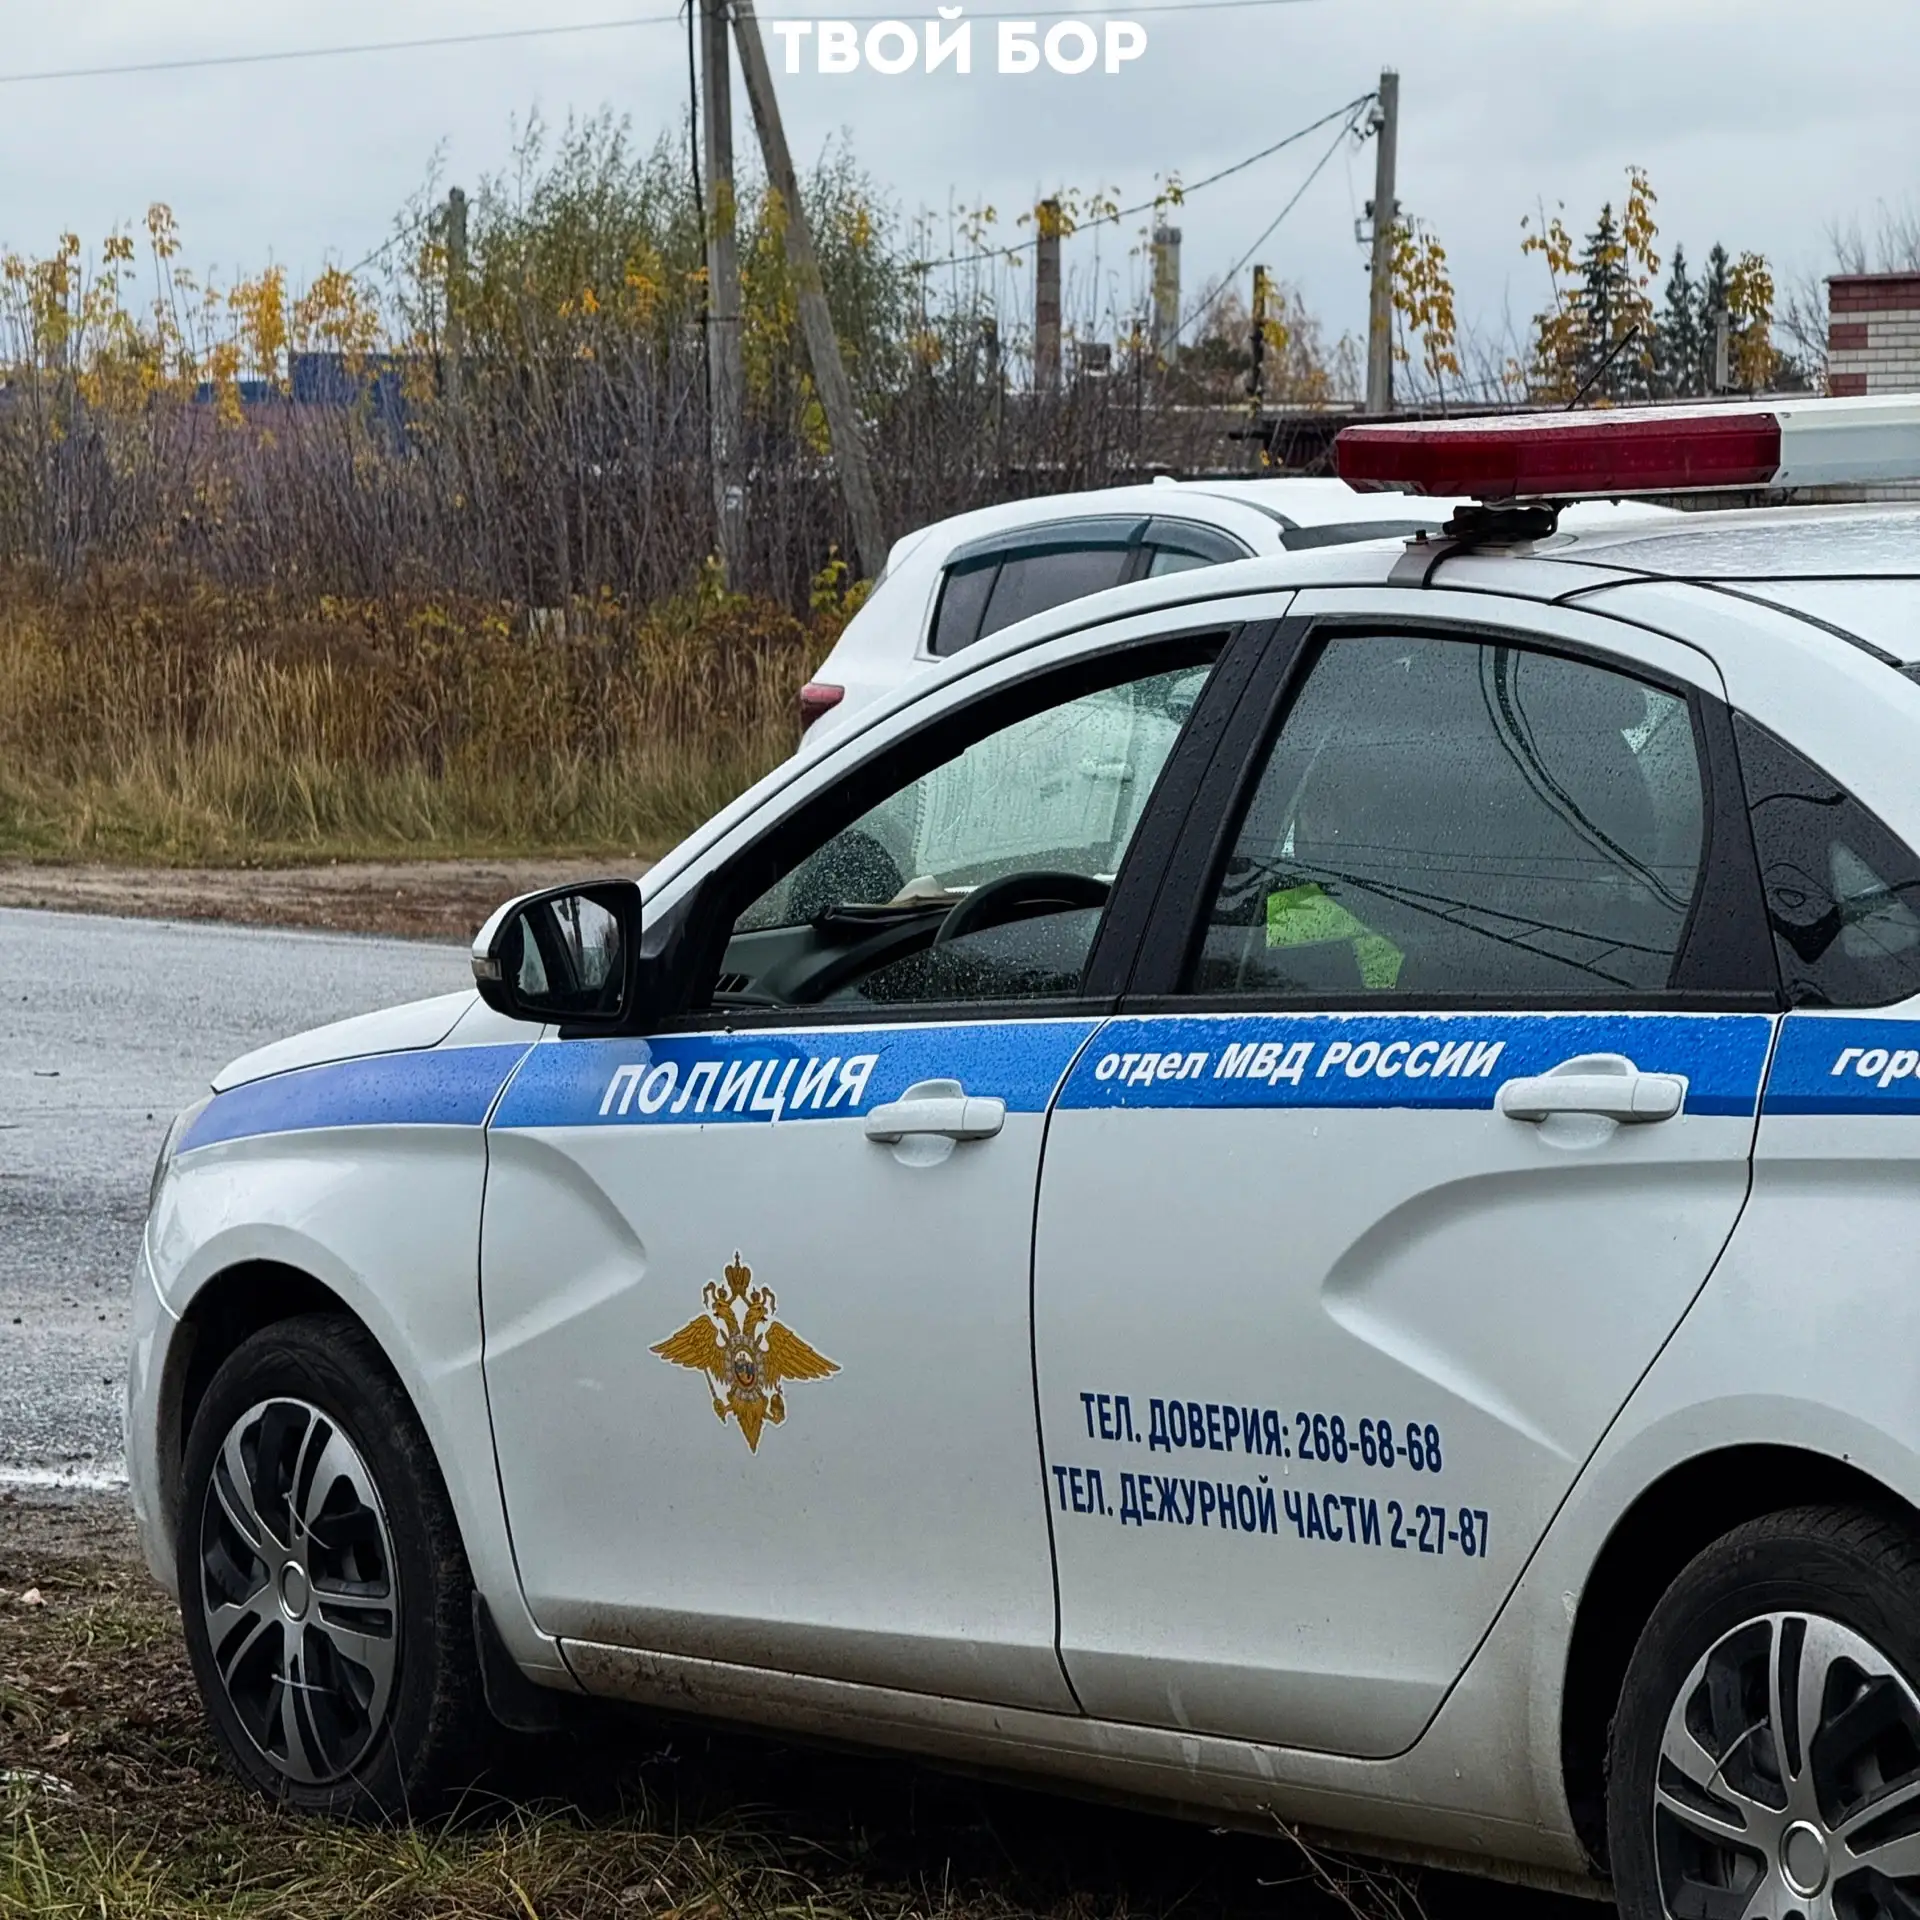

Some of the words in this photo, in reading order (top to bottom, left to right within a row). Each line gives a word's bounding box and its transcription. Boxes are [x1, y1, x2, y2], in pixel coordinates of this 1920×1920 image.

[599, 1054, 879, 1122] ПОЛИЦИЯ
[1095, 1052, 1208, 1087] отдел
[1213, 1042, 1315, 1086] МВД
[1316, 1041, 1506, 1078] РОССИИ
[1830, 1047, 1920, 1088] гор
[1080, 1392, 1142, 1443] ТЕЛ.
[1148, 1398, 1291, 1458] ДОВЕРИЯ:
[1296, 1412, 1443, 1474] 268-68-68
[1052, 1465, 1114, 1517] ТЕЛ.
[1120, 1472, 1278, 1535] ДЕЖУРНОЙ
[1283, 1489, 1382, 1547] ЧАСТИ
[1389, 1500, 1489, 1558] 2-27-87
